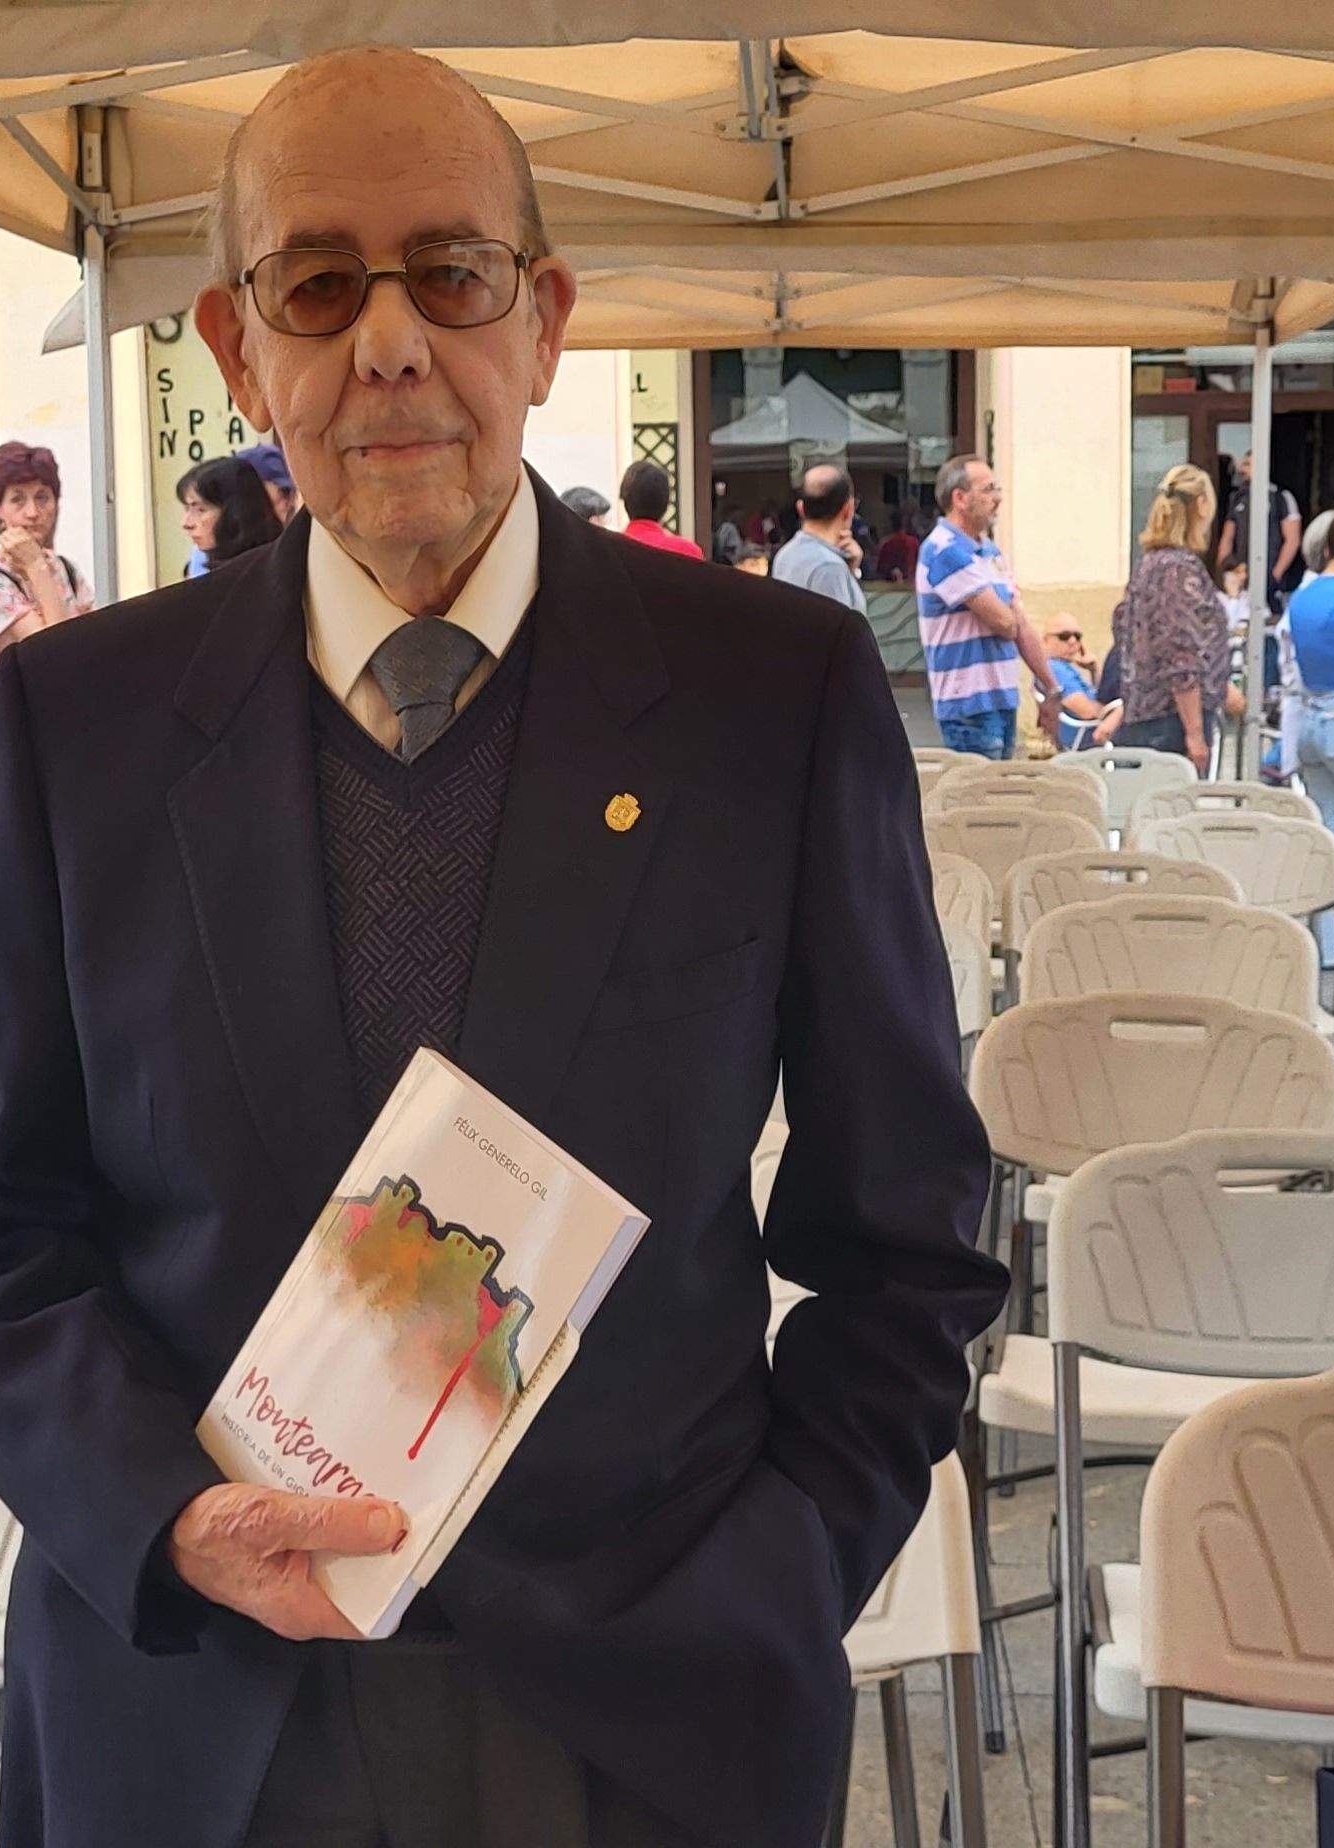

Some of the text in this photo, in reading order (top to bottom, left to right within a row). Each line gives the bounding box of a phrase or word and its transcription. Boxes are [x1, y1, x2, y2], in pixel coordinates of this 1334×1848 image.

[453, 1116, 548, 1202] FÉLIX GENERELO GIL
[221, 1413, 257, 1453] HISTORIA
[257, 1451, 269, 1465] DE
[271, 1463, 285, 1480] UN
[236, 1366, 408, 1554] Monteara
